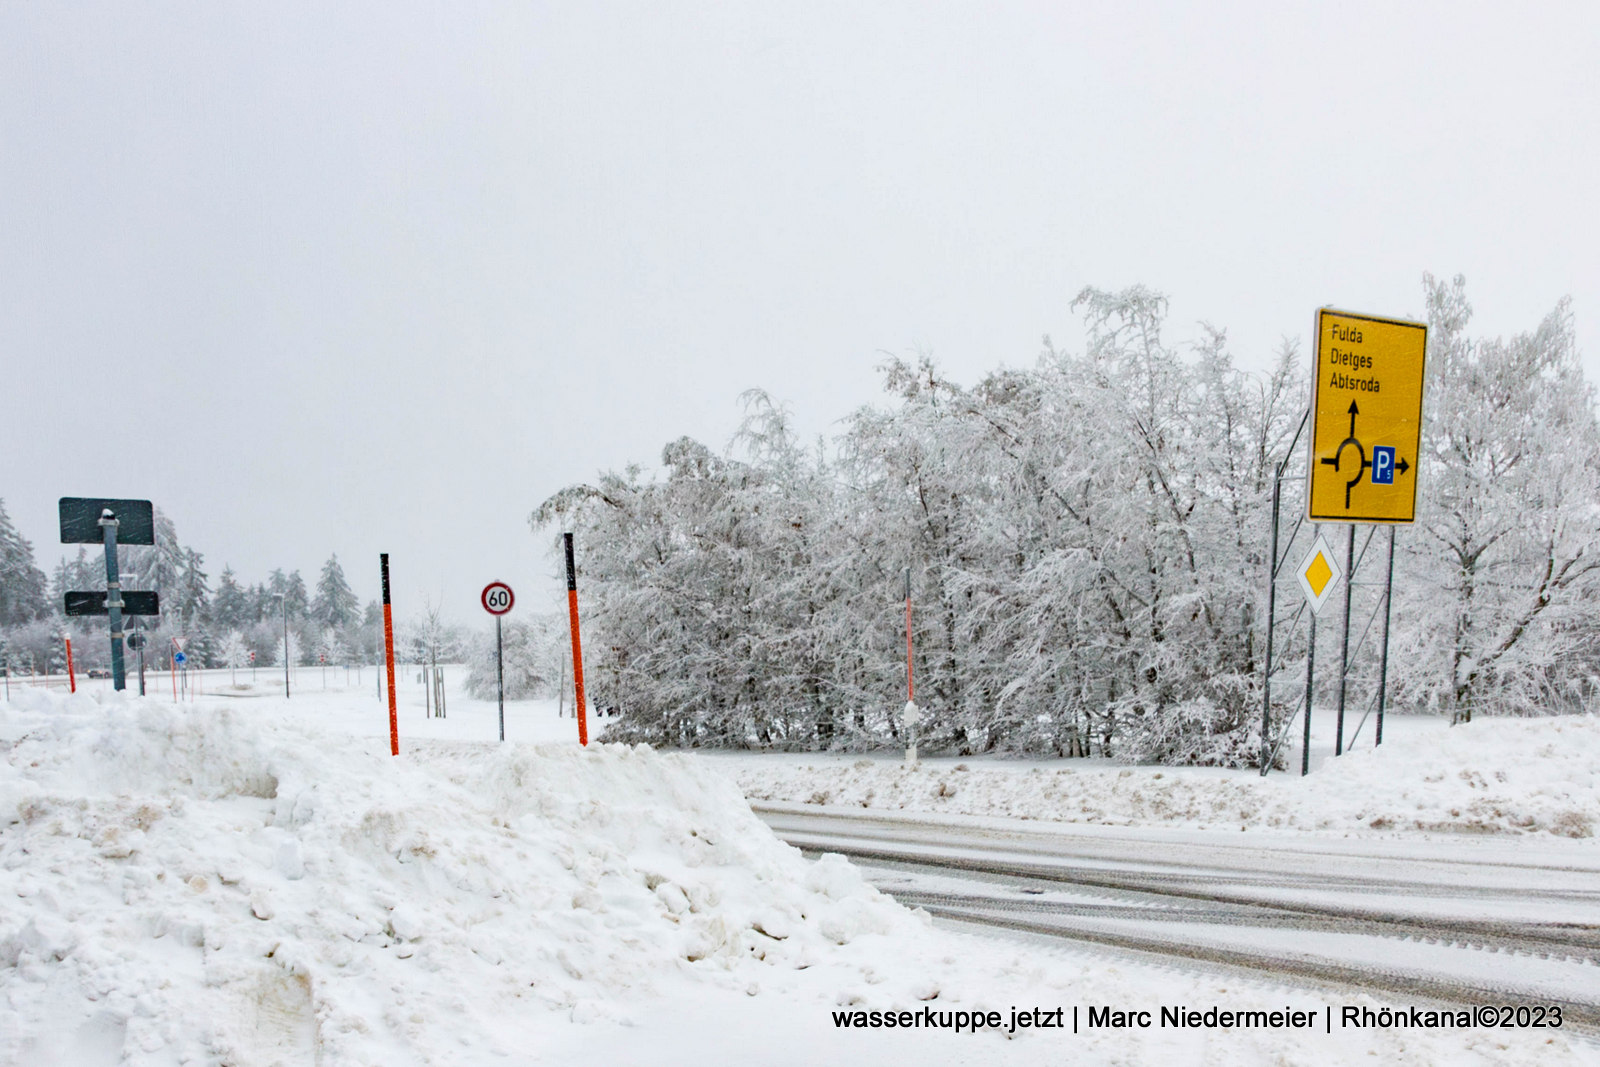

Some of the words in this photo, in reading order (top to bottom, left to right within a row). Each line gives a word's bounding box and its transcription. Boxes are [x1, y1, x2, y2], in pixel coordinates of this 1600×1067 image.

[1332, 324, 1363, 344] Fulda
[1330, 348, 1373, 371] Dietges
[1330, 372, 1380, 393] Abtsroda
[1377, 451, 1390, 479] P
[489, 591, 508, 607] 60
